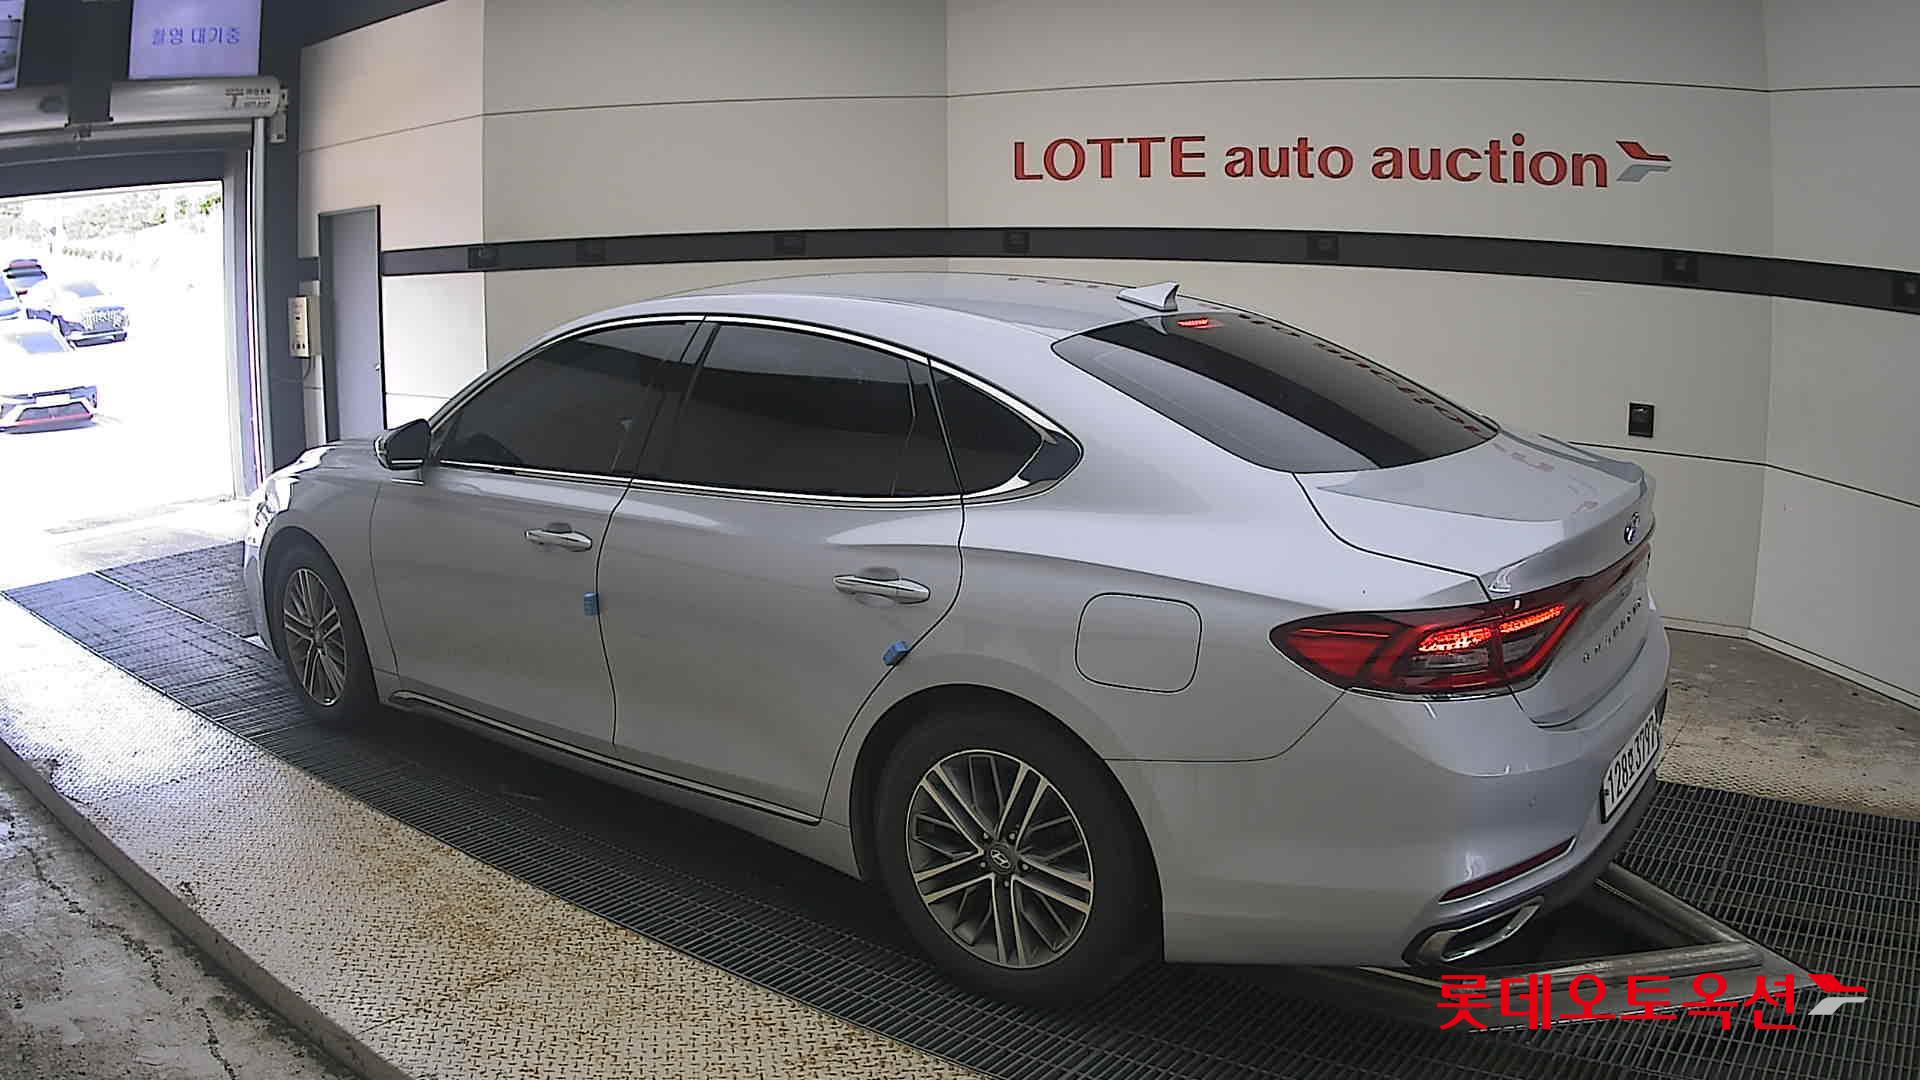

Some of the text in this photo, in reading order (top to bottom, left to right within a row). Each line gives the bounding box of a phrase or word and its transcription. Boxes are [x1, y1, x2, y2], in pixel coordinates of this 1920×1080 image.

[1014, 133, 1608, 188] LOTTE auto auction
